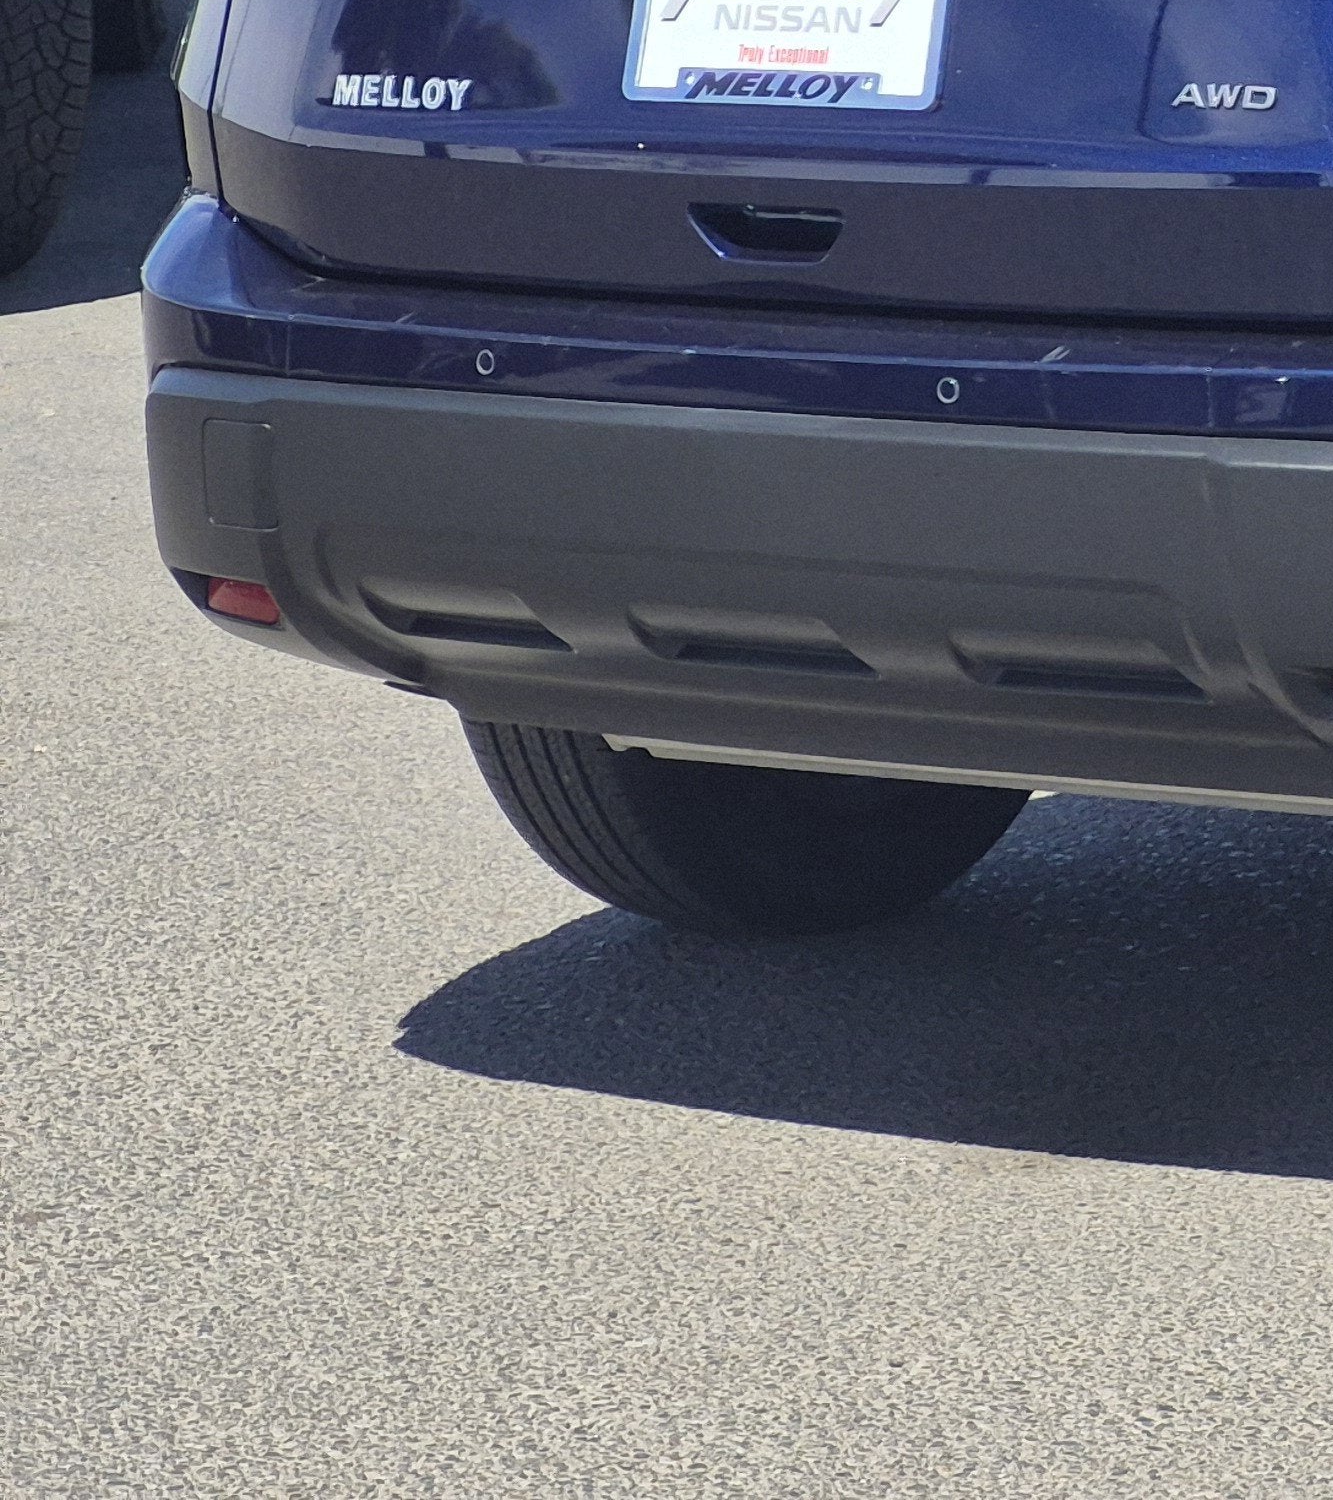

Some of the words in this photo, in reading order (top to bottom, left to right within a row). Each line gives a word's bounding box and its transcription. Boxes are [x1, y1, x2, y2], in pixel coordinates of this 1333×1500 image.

[713, 3, 863, 34] NISSAN
[737, 43, 765, 65] Truly
[768, 45, 831, 66] Exceptional
[332, 73, 473, 111] MELLOY
[684, 71, 860, 104] MELLOY
[1170, 82, 1278, 110] AWD
